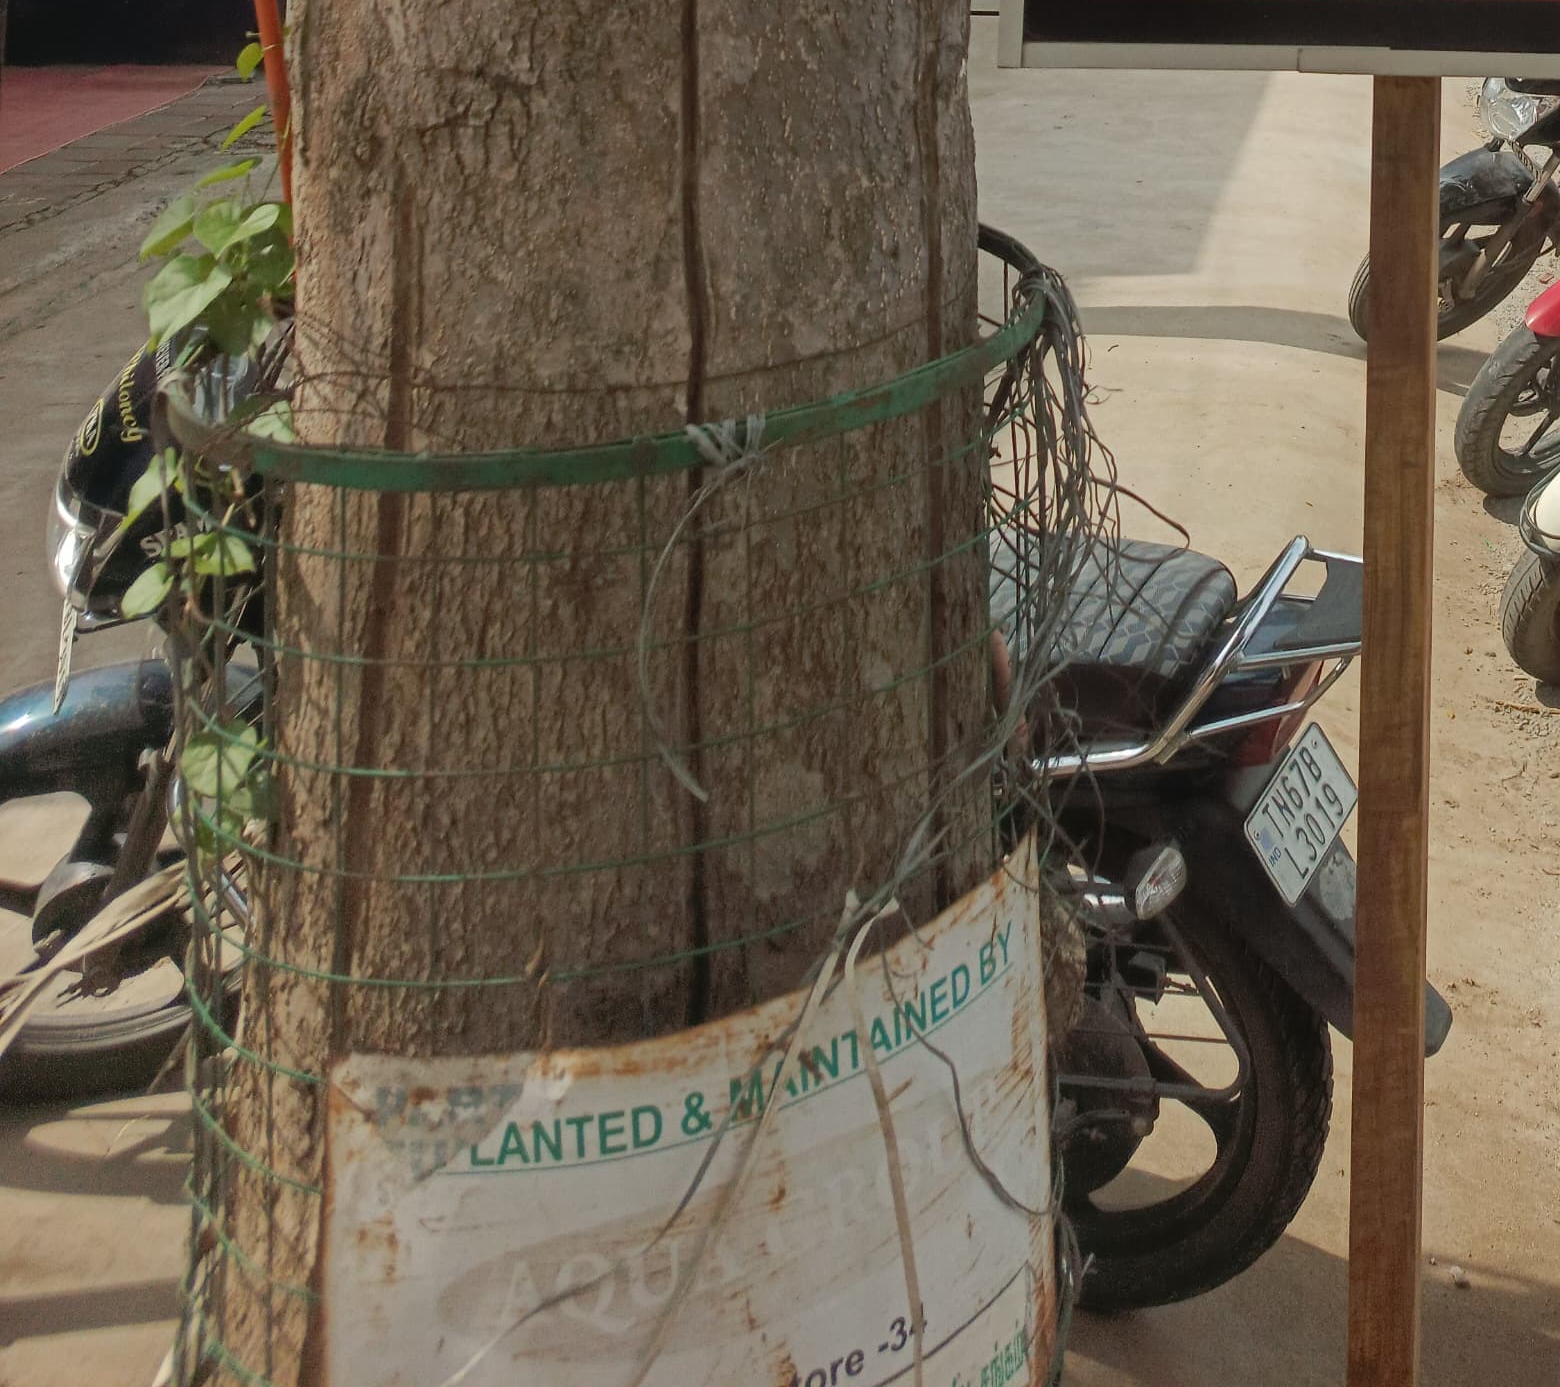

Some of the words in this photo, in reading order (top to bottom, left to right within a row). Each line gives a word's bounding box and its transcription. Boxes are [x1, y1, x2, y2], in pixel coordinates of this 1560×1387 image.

[1284, 782, 1345, 880] L3019
[680, 1090, 713, 1137] &
[978, 918, 1013, 986] BY
